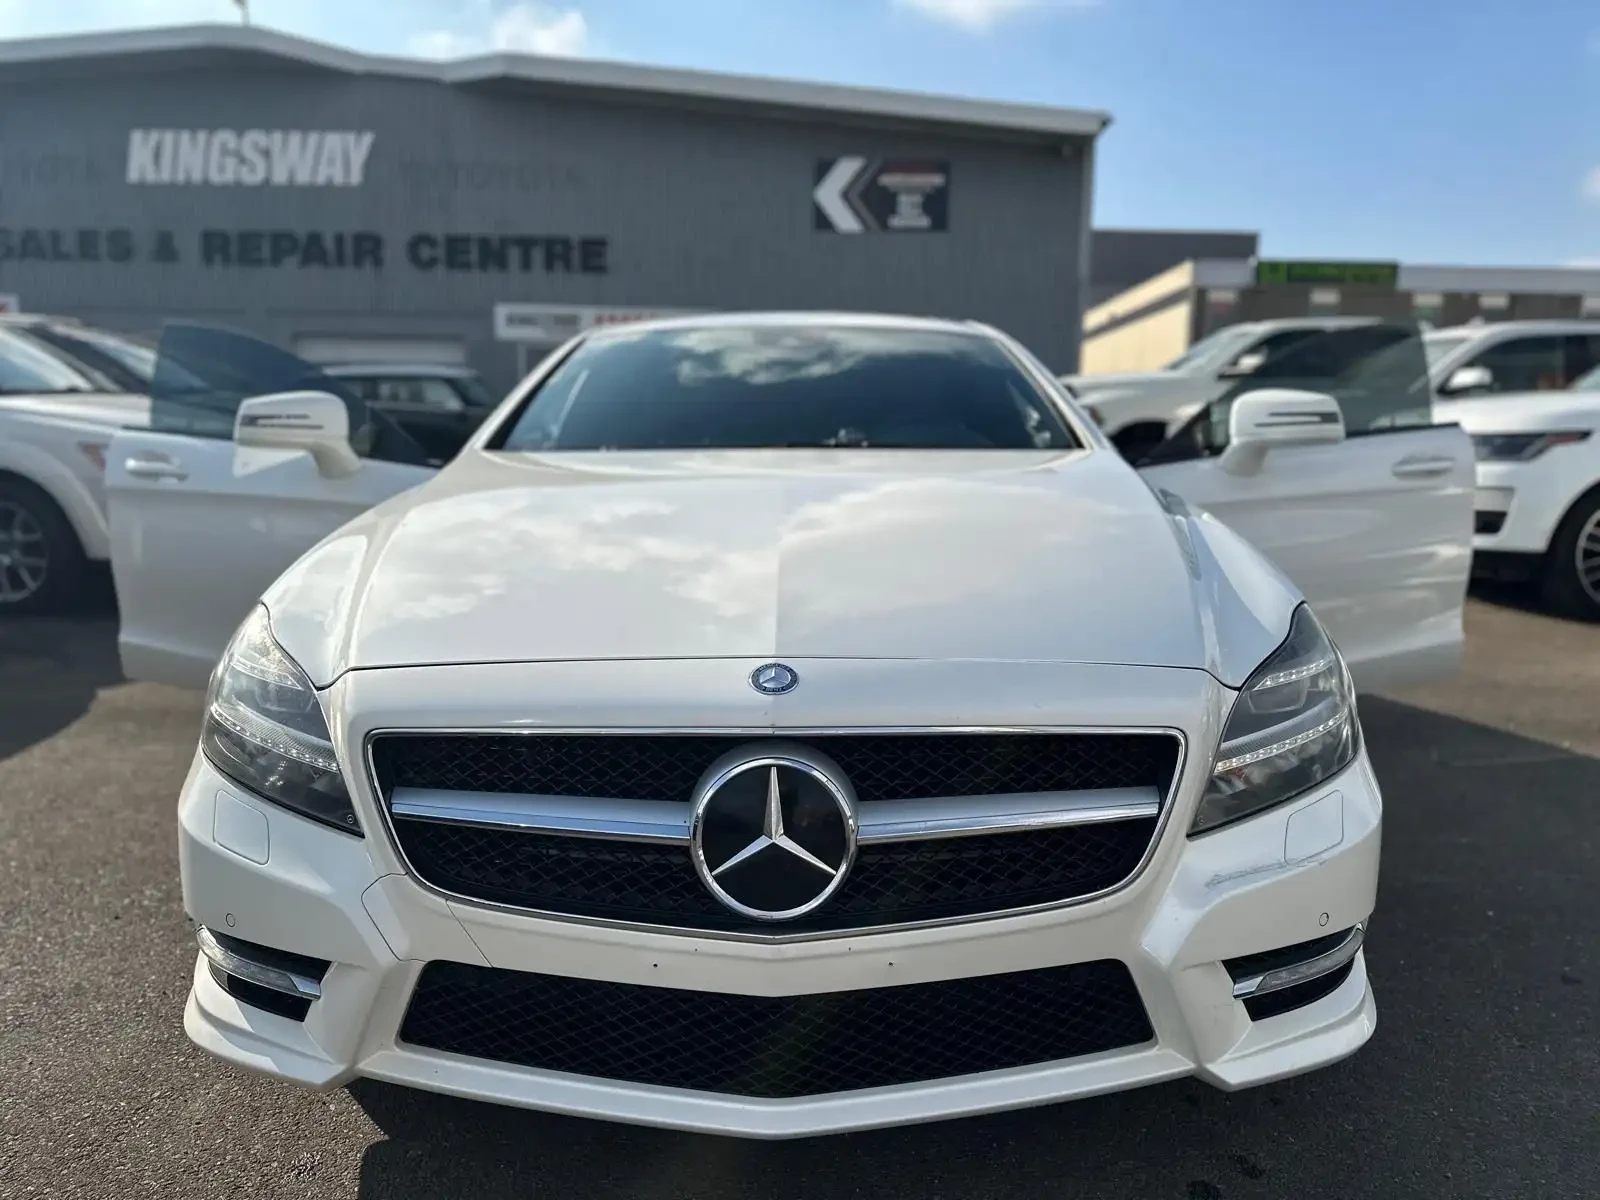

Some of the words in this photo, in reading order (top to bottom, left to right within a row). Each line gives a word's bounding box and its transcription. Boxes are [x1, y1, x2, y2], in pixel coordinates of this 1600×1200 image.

[127, 129, 375, 186] KINGSWAY
[202, 231, 384, 270] REPAIR
[405, 232, 609, 275] CENTRE
